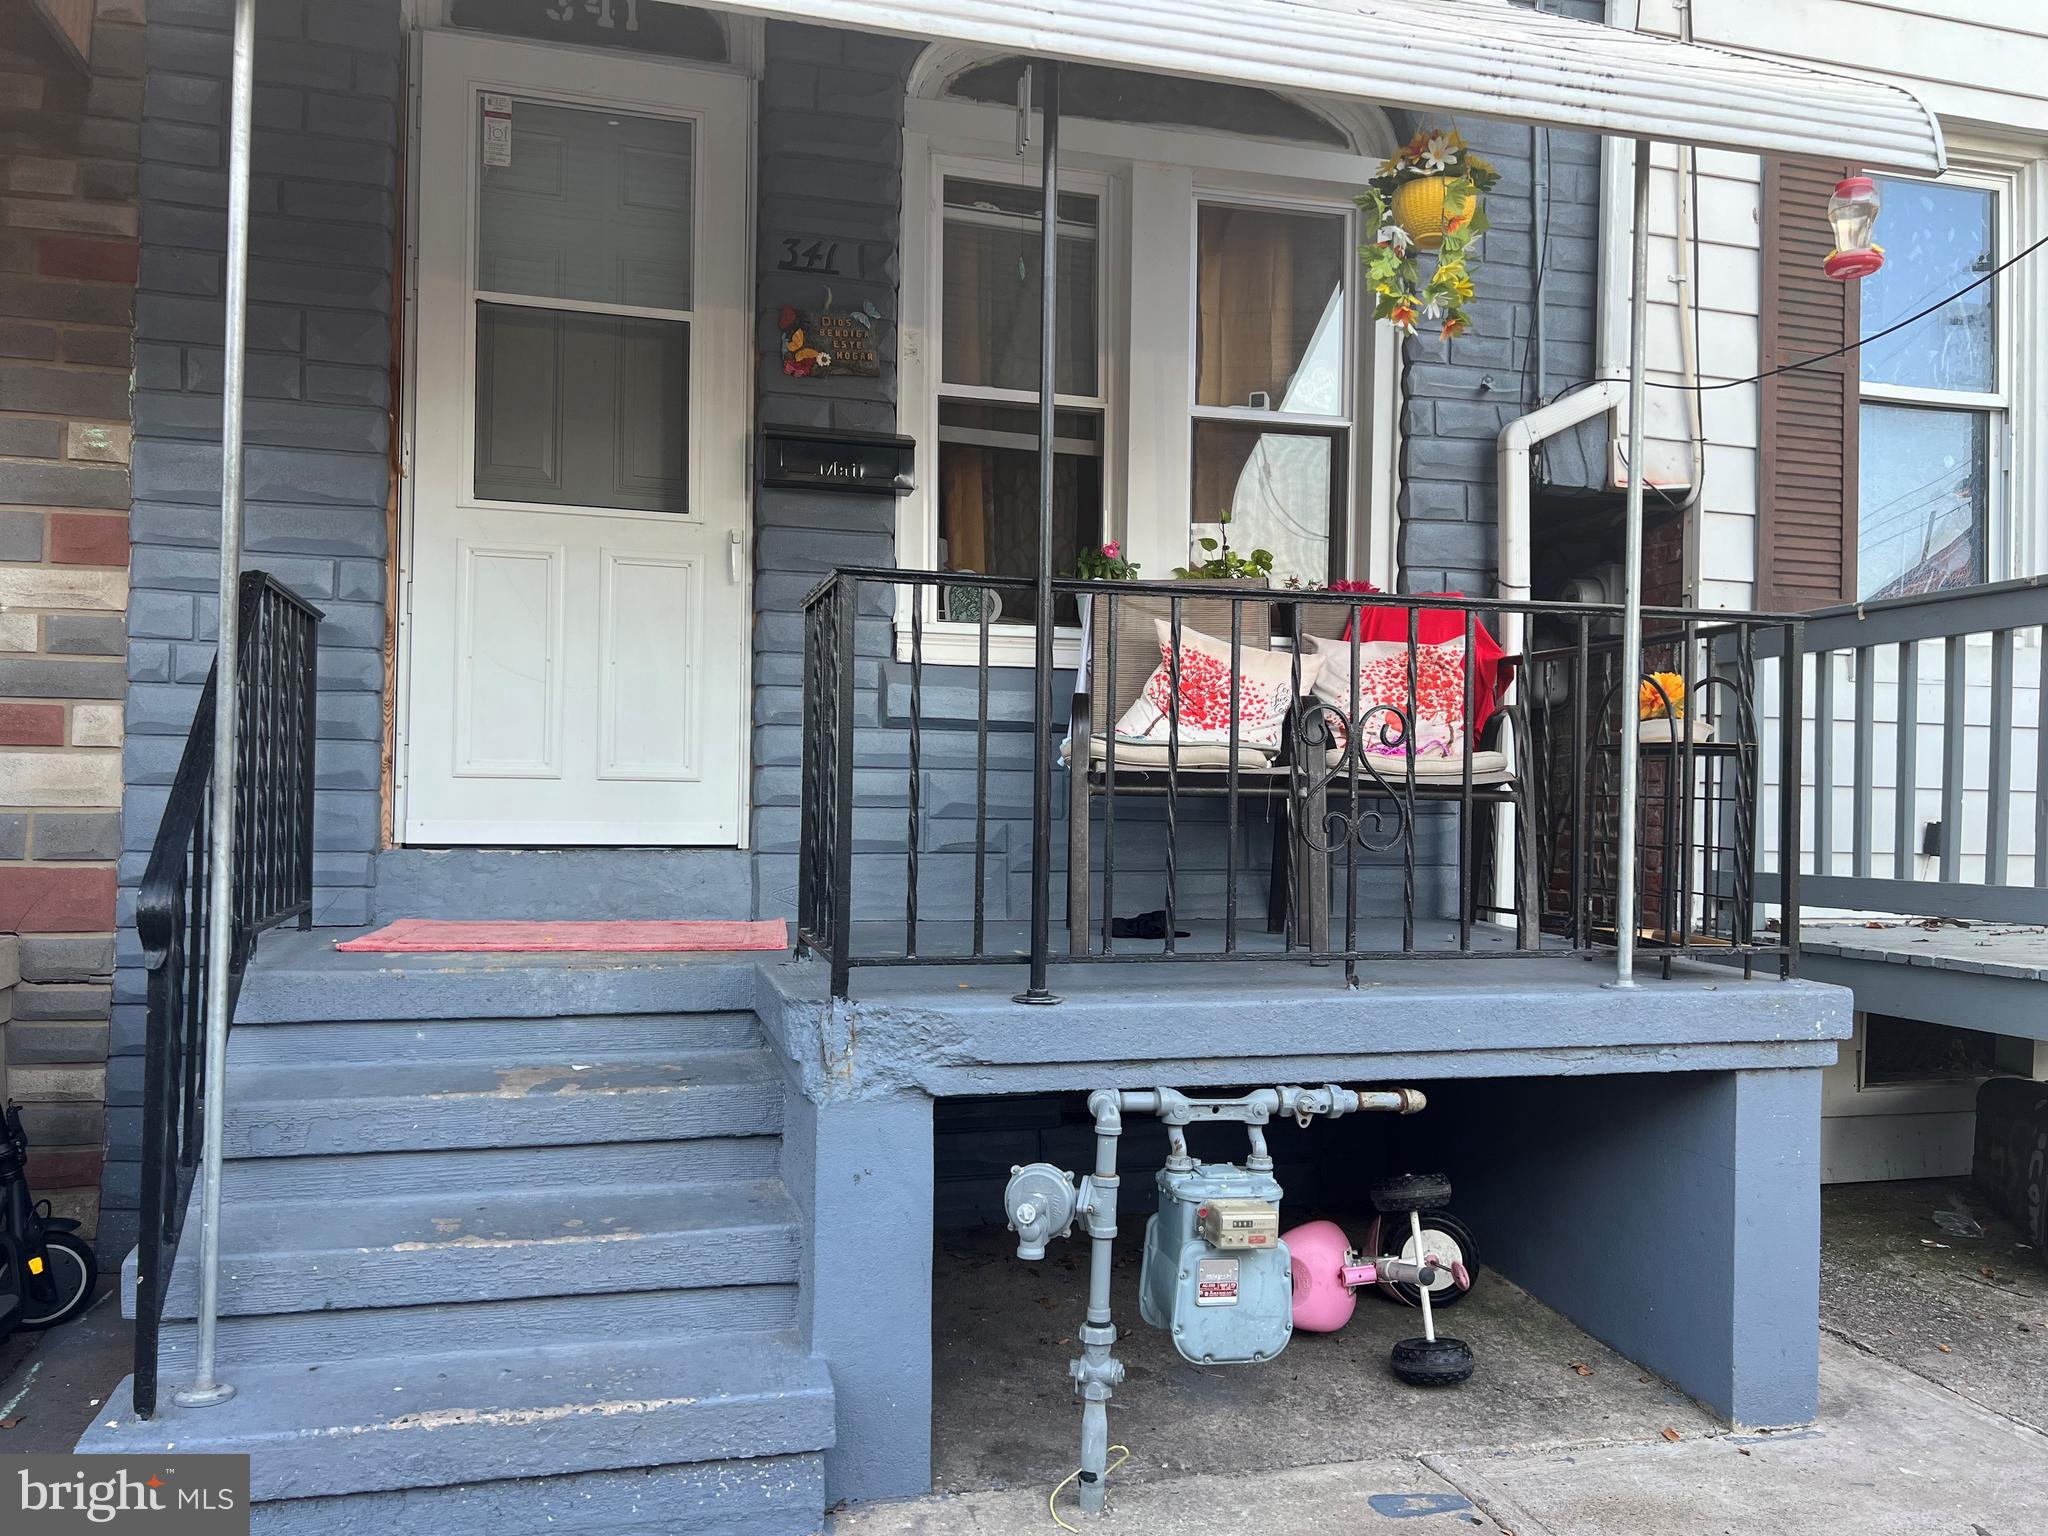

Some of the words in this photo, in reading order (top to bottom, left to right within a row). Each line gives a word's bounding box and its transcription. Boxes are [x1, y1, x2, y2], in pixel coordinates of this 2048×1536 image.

[778, 238, 839, 275] 341
[833, 340, 863, 349] ESTE
[836, 351, 873, 361] HOGAR
